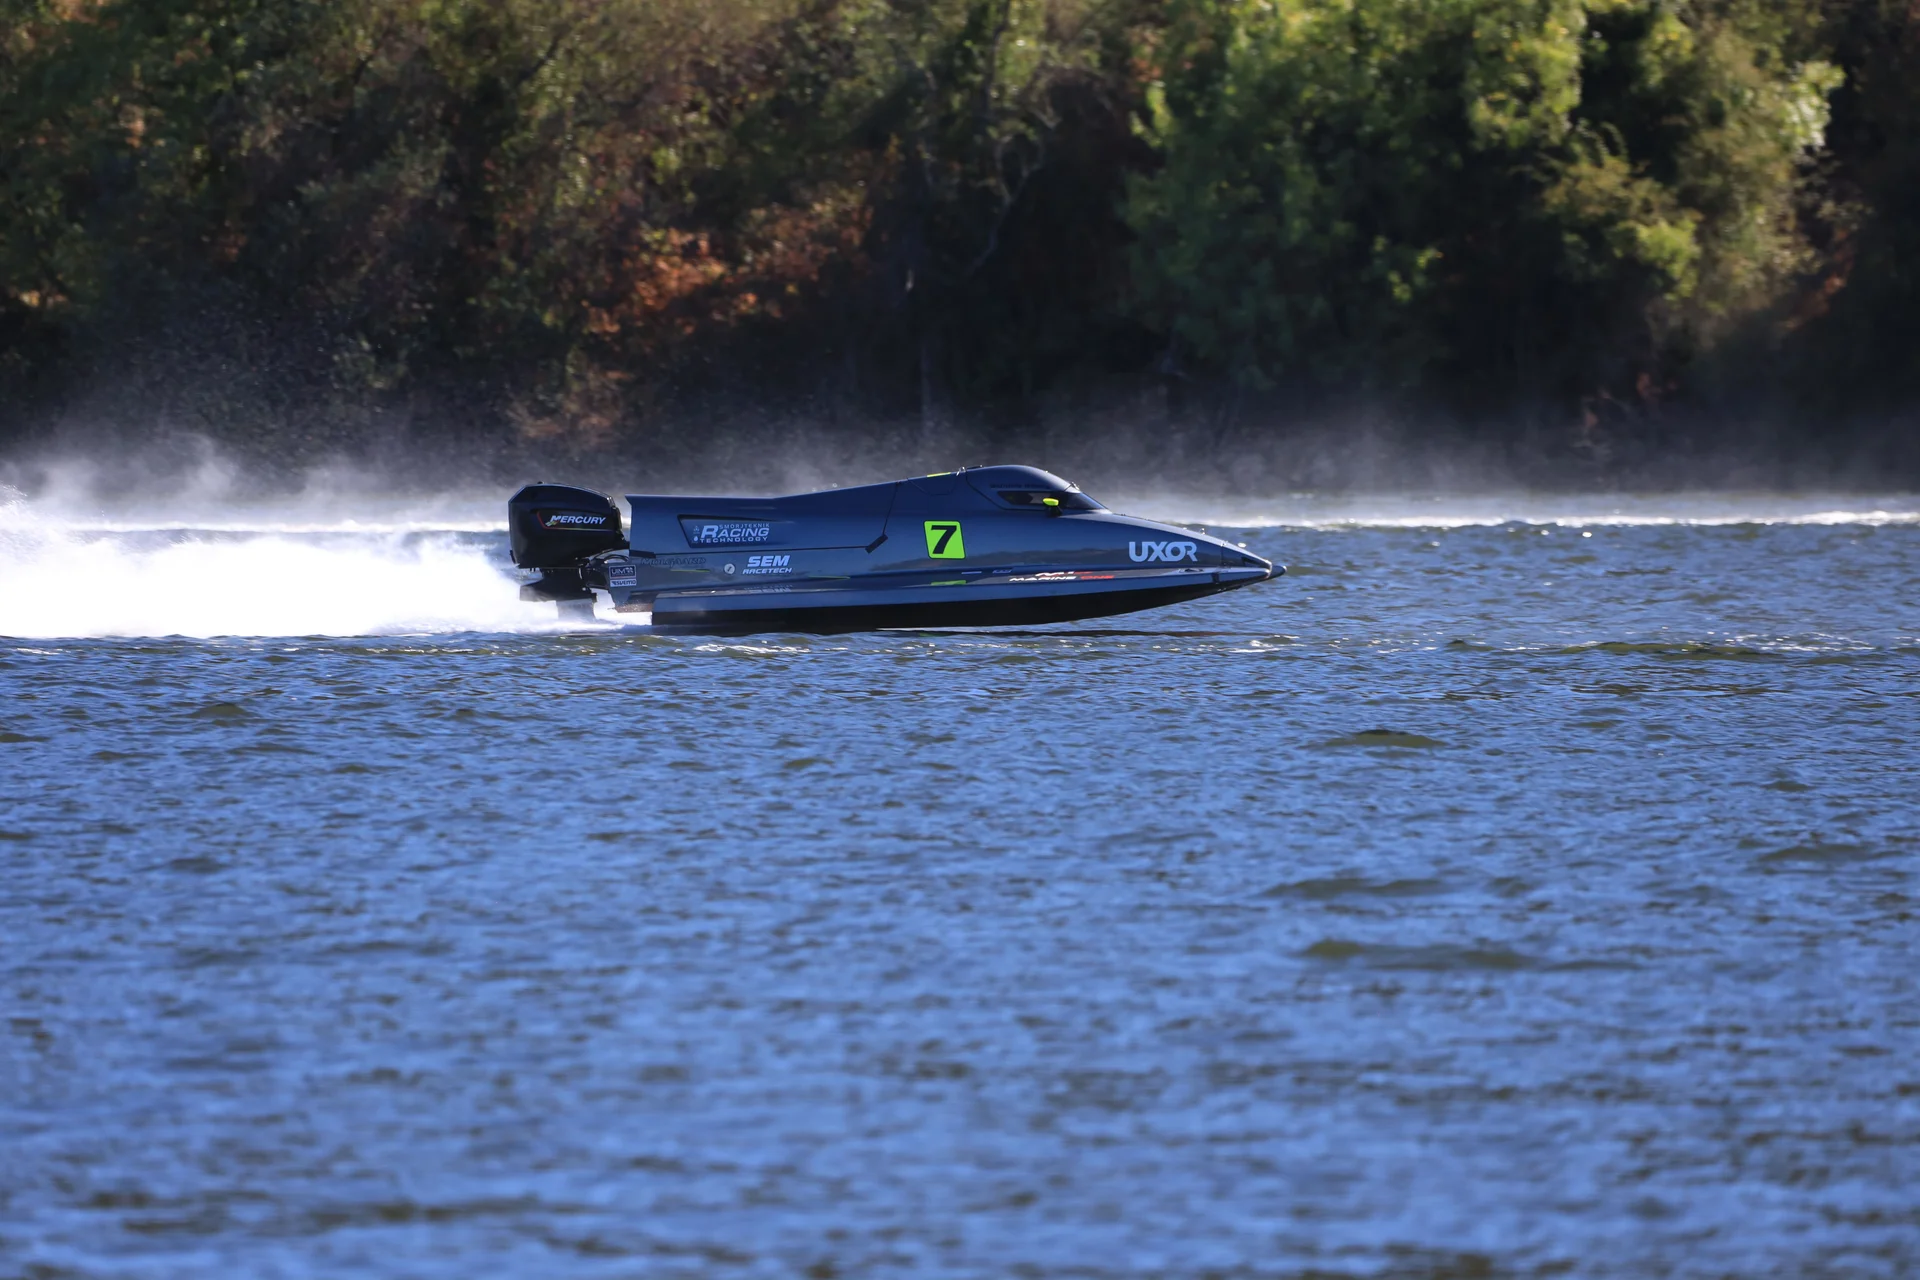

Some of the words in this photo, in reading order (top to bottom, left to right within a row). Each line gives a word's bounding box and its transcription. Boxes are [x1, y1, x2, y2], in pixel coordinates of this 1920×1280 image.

[546, 515, 606, 526] MERCURY
[930, 525, 957, 554] 7
[1129, 541, 1198, 562] UXOR
[747, 555, 790, 567] SEM
